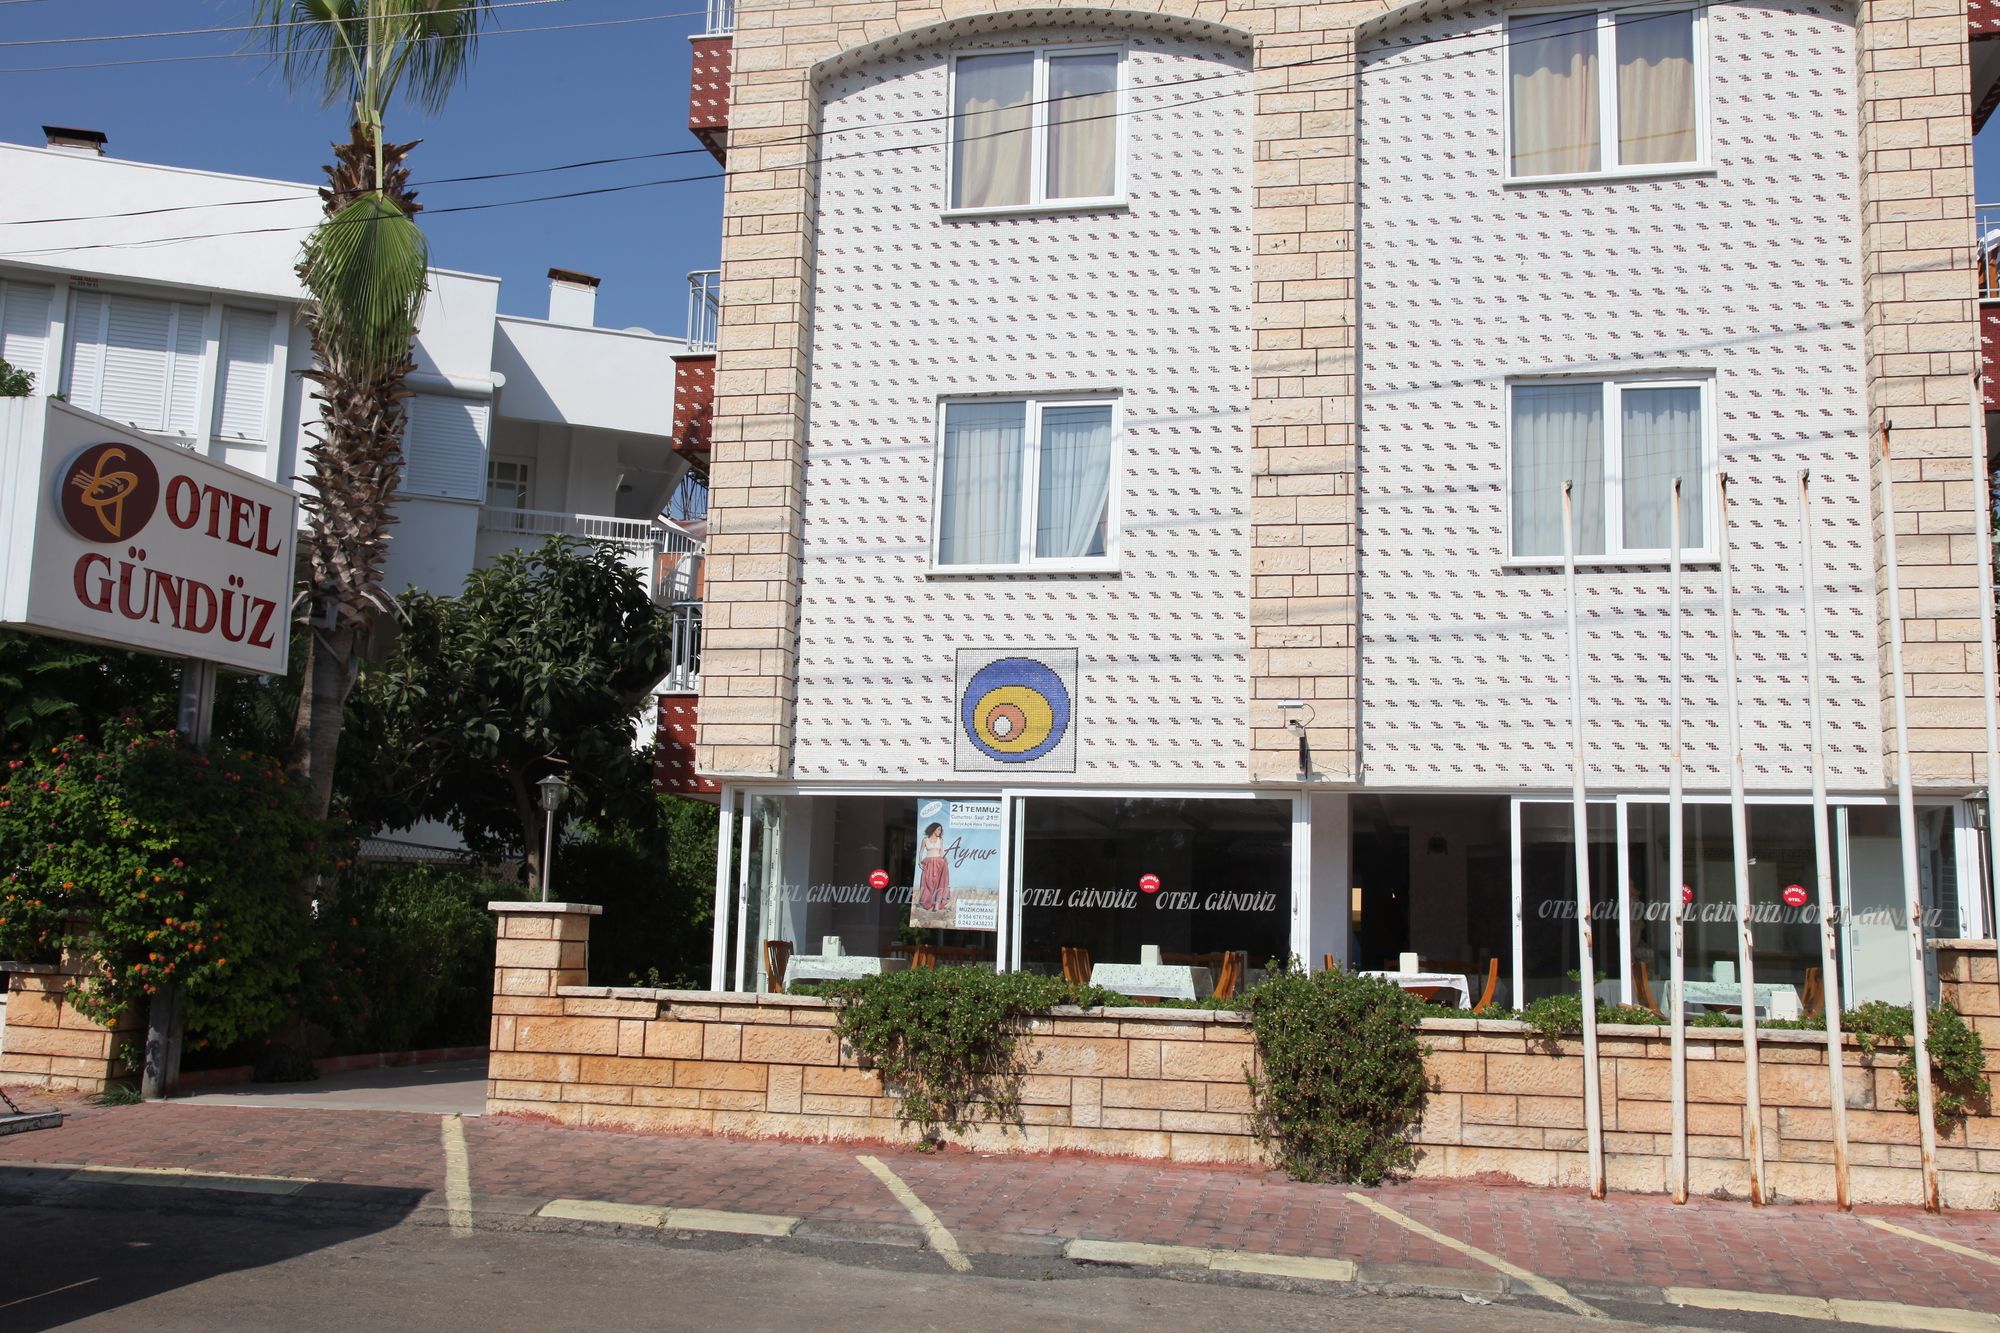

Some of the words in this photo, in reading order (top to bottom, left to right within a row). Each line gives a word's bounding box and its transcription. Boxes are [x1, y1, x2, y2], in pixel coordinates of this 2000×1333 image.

[165, 474, 282, 557] OTEL
[73, 546, 277, 649] GÜNDÜZ
[951, 804, 964, 812] 21
[943, 836, 998, 868] Aynur
[806, 883, 871, 904] GÜNDÜZ
[1022, 888, 1064, 906] OTEL
[1067, 887, 1138, 909] GÜNDÜZ
[1155, 891, 1201, 910] OTEL
[1204, 890, 1277, 912] GÜNDÜZ
[1538, 899, 1579, 919] OTE
[1645, 902, 1697, 921] OTL
[1859, 903, 1943, 928] GÜNÜZ
